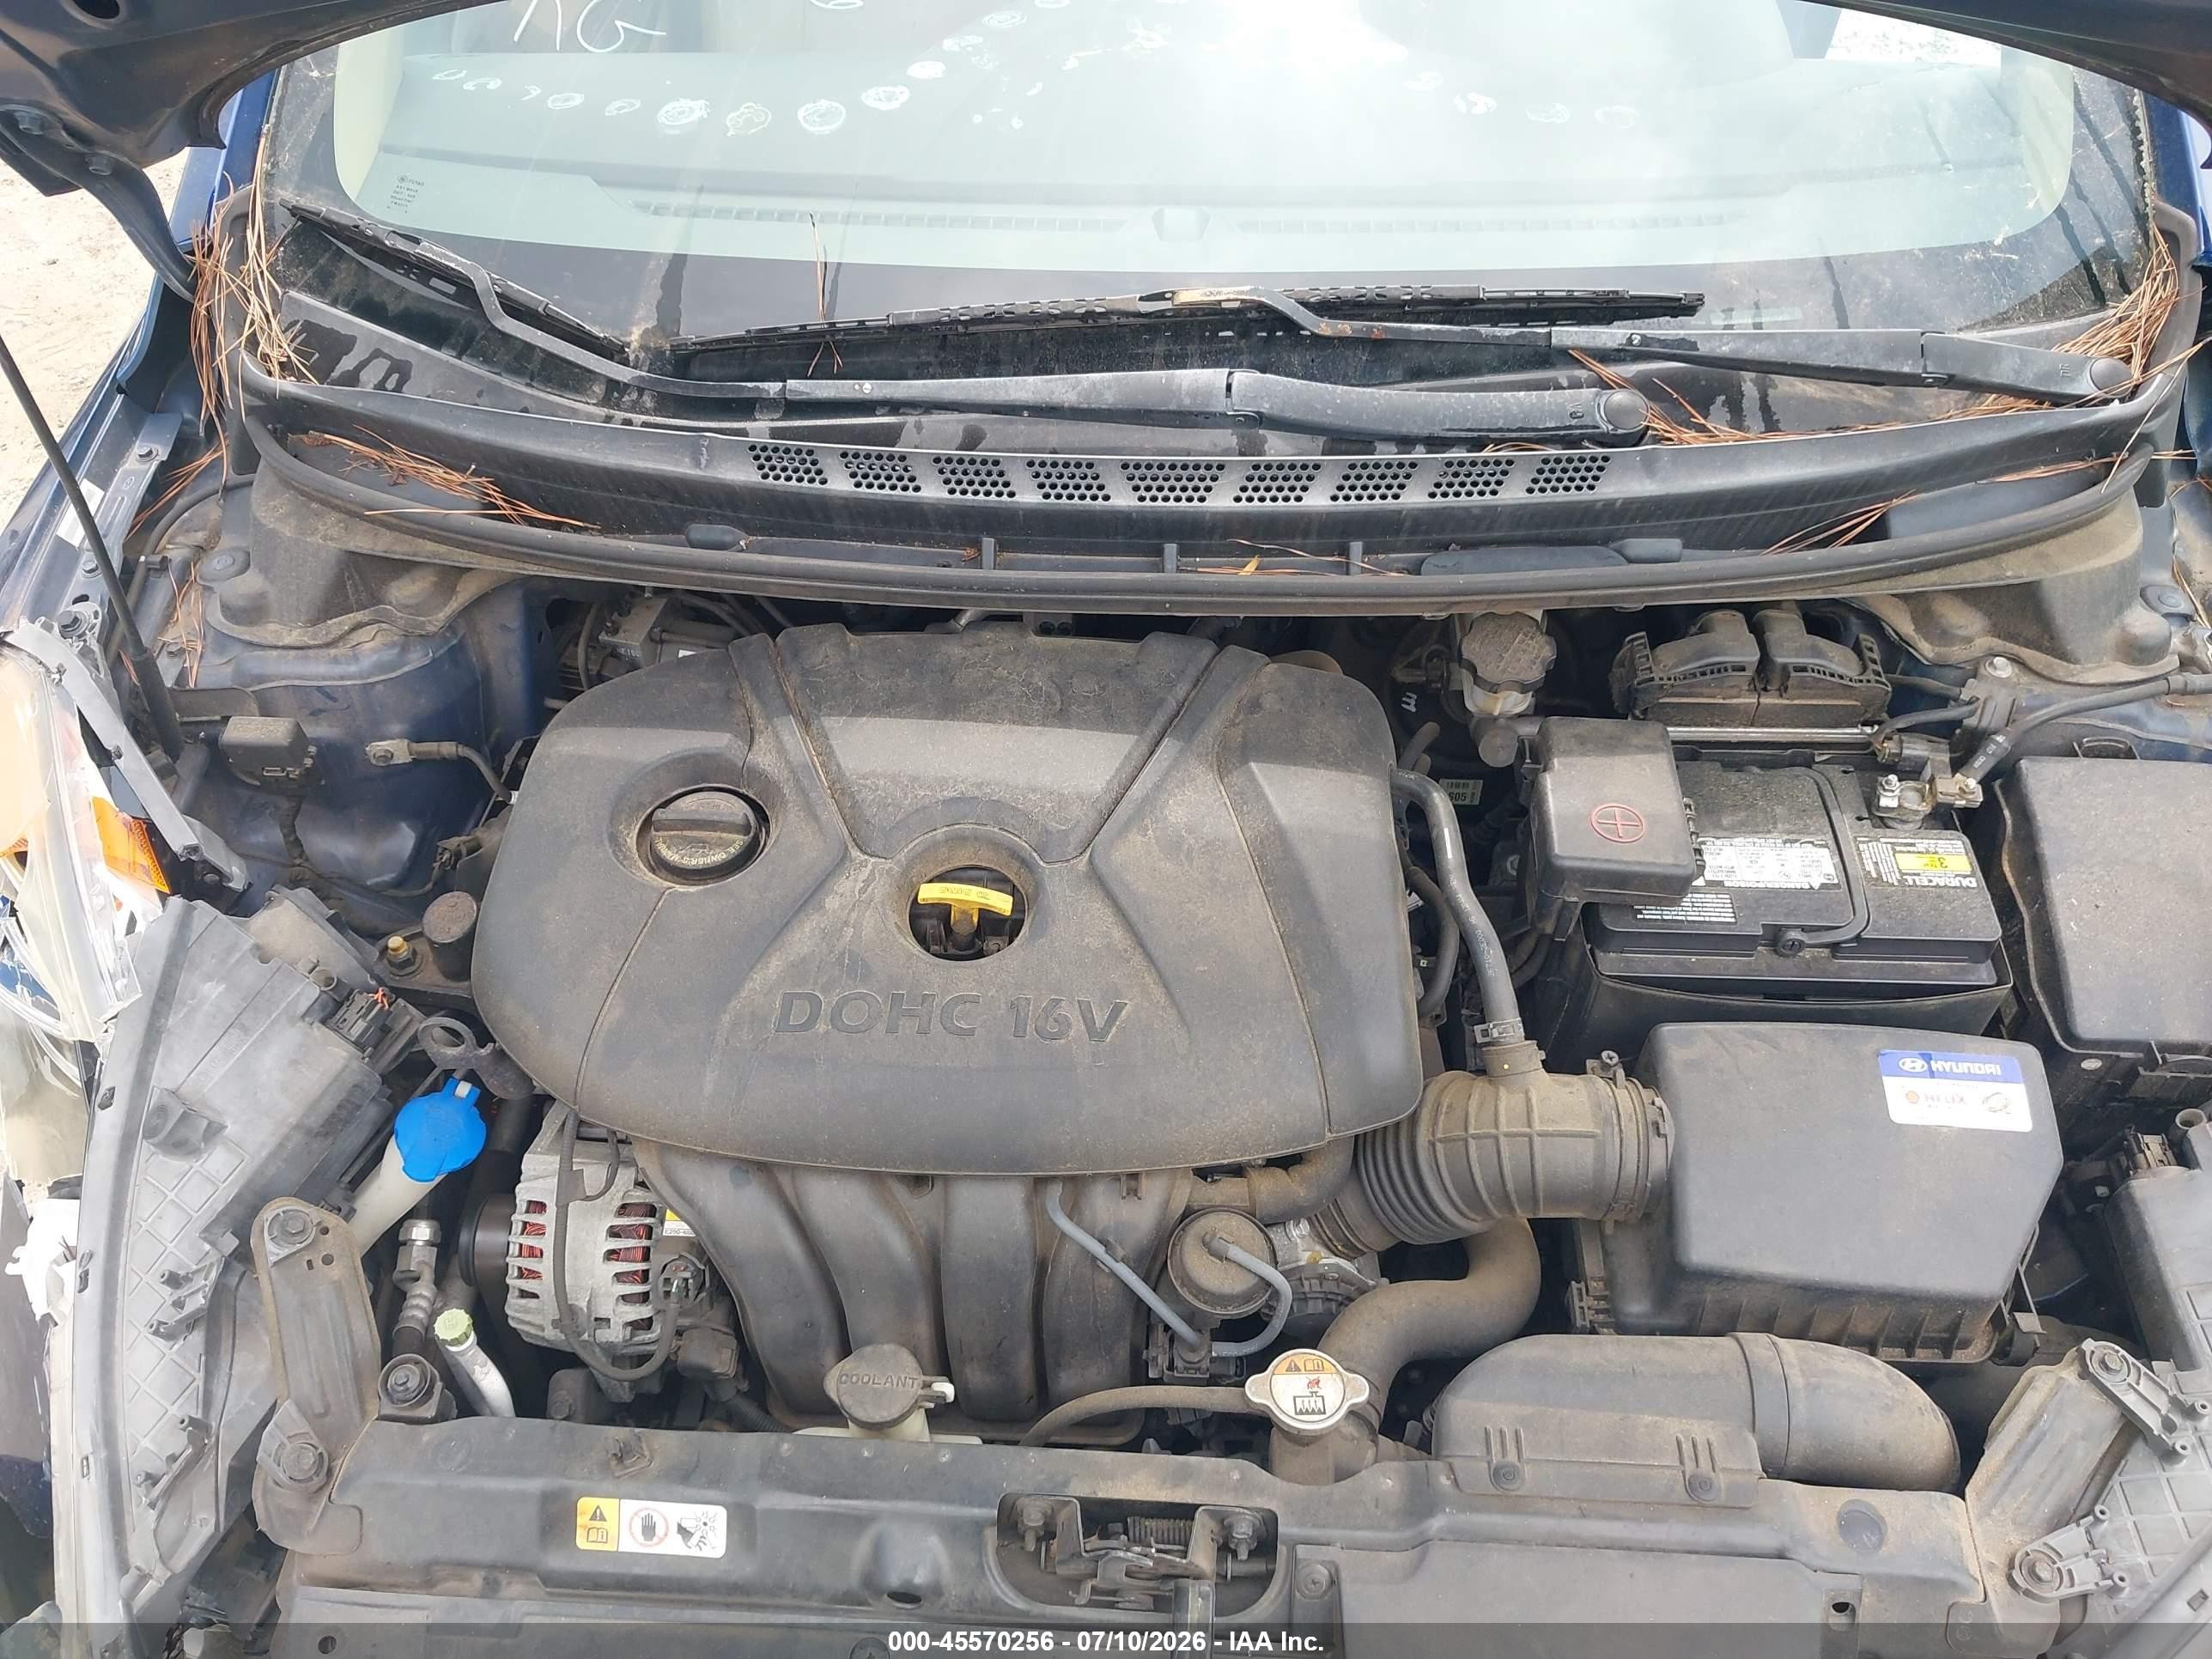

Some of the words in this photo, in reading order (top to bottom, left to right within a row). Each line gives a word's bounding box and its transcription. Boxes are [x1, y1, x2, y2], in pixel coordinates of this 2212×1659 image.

[1902, 875, 1978, 888] DURACELL
[775, 990, 982, 1036] DOHC
[1009, 994, 1130, 1042] 16V
[1930, 1059, 2002, 1076] HYUNDAI
[839, 1372, 919, 1389] COOLANT
